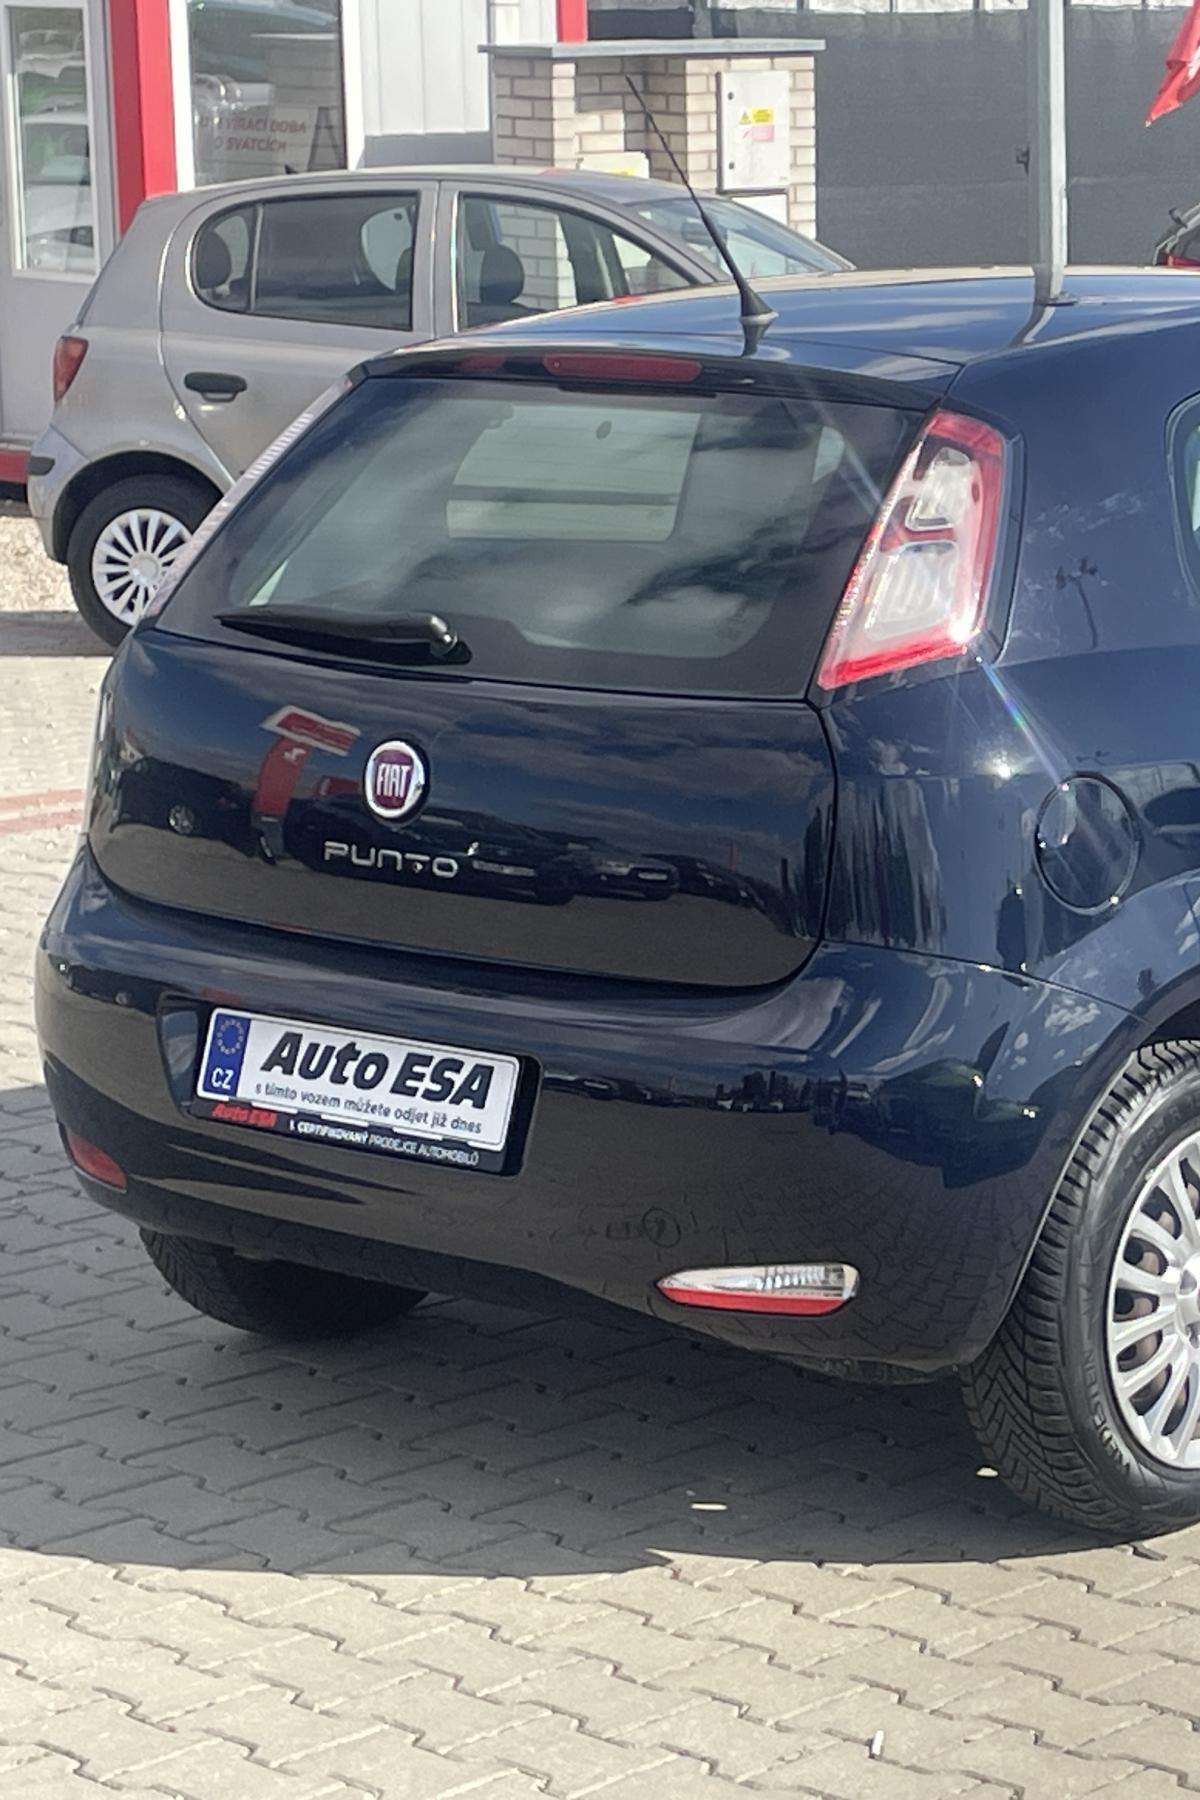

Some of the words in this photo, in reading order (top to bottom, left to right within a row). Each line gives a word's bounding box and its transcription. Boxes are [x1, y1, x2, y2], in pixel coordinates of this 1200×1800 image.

[376, 763, 411, 798] FIAT
[324, 841, 459, 878] PUNTO
[211, 1066, 234, 1091] CZ
[260, 1031, 390, 1090] Auto
[390, 1052, 495, 1109] ESA
[255, 1083, 262, 1095] s
[300, 1091, 340, 1107] vozem
[394, 1107, 429, 1124] odjet
[450, 1116, 482, 1134] dnes
